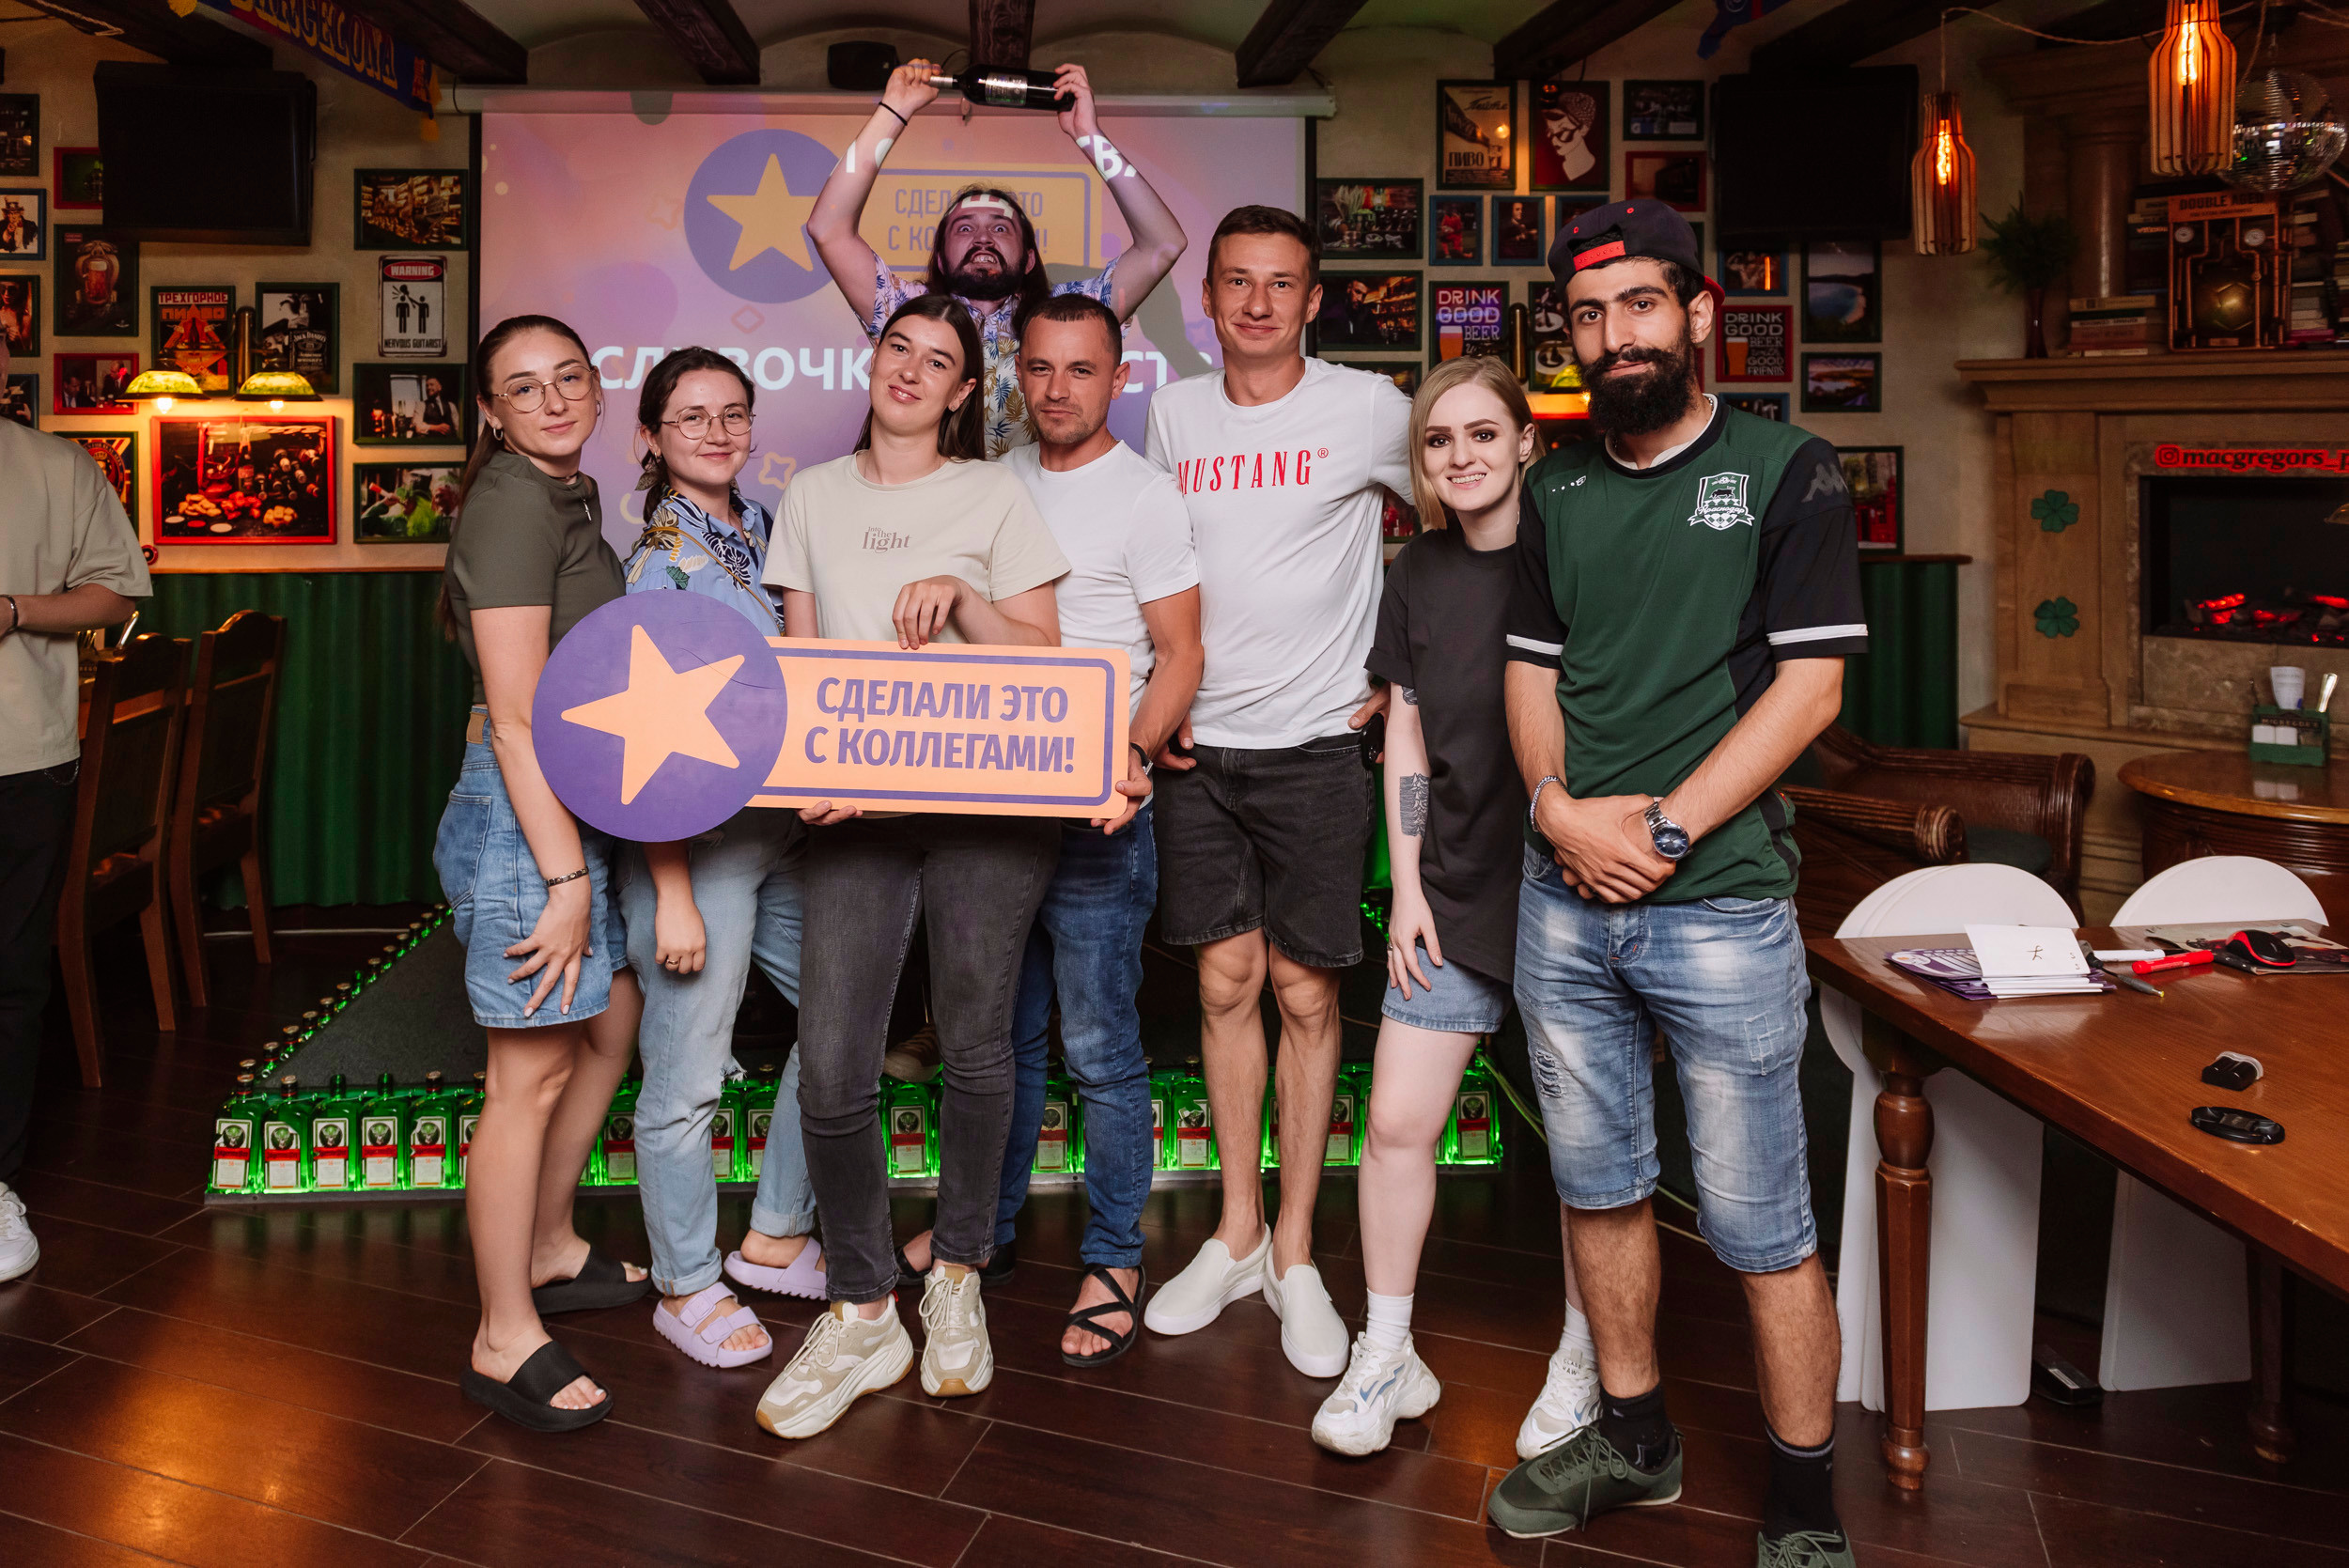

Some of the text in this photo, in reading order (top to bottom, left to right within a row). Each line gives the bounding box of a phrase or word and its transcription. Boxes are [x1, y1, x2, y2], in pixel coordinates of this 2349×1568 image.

[229, 0, 398, 90] ARCELONA
[1449, 152, 1484, 166] ПИВО
[2179, 194, 2227, 210] DOUBLE
[391, 266, 435, 276] WARNING
[159, 292, 227, 303] ТРЕХГОРНОЕ
[1439, 289, 1501, 305] DRINK
[1439, 306, 1501, 324] GOOD
[1725, 313, 1782, 324] DRINK
[1464, 326, 1501, 341] BEER
[1725, 324, 1783, 336] GOOD
[384, 339, 412, 349] NERVOUS
[1750, 336, 1782, 348] BEER
[1748, 356, 1784, 366] GOOD
[1748, 365, 1785, 377] FRIENDS
[877, 530, 893, 538] the
[862, 531, 912, 553] light
[817, 677, 1069, 723] СДЕЛАЛИ ЭТО
[804, 726, 1075, 774] С КОЛЛЕГАМИ!
